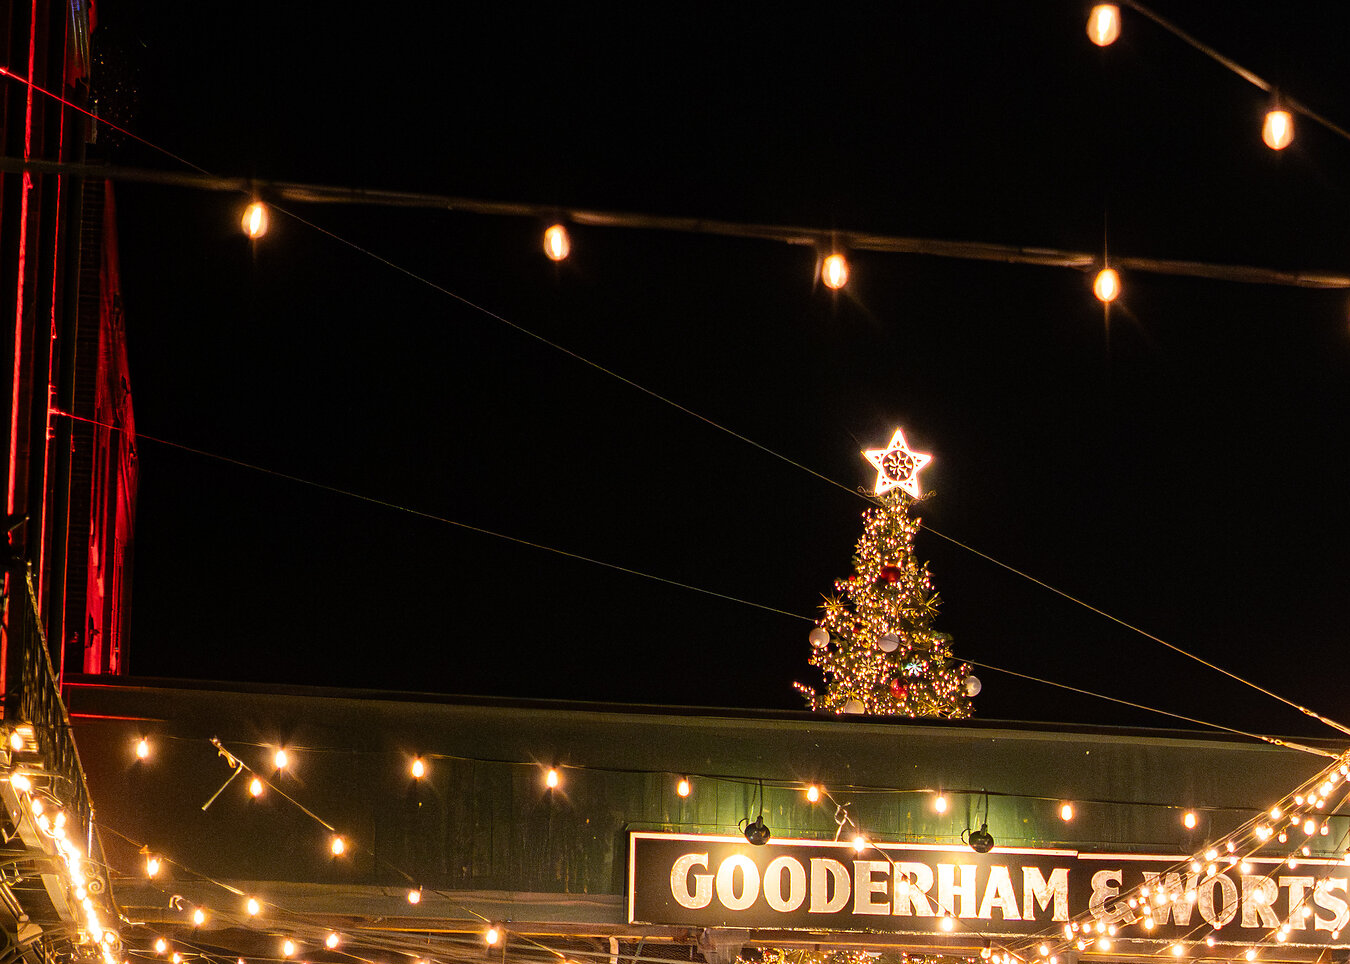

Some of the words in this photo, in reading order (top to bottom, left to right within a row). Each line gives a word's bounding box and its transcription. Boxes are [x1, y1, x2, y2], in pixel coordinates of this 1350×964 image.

[670, 853, 1071, 922] GOODERHAM
[1089, 869, 1138, 924] &
[1142, 871, 1350, 932] WORTS
